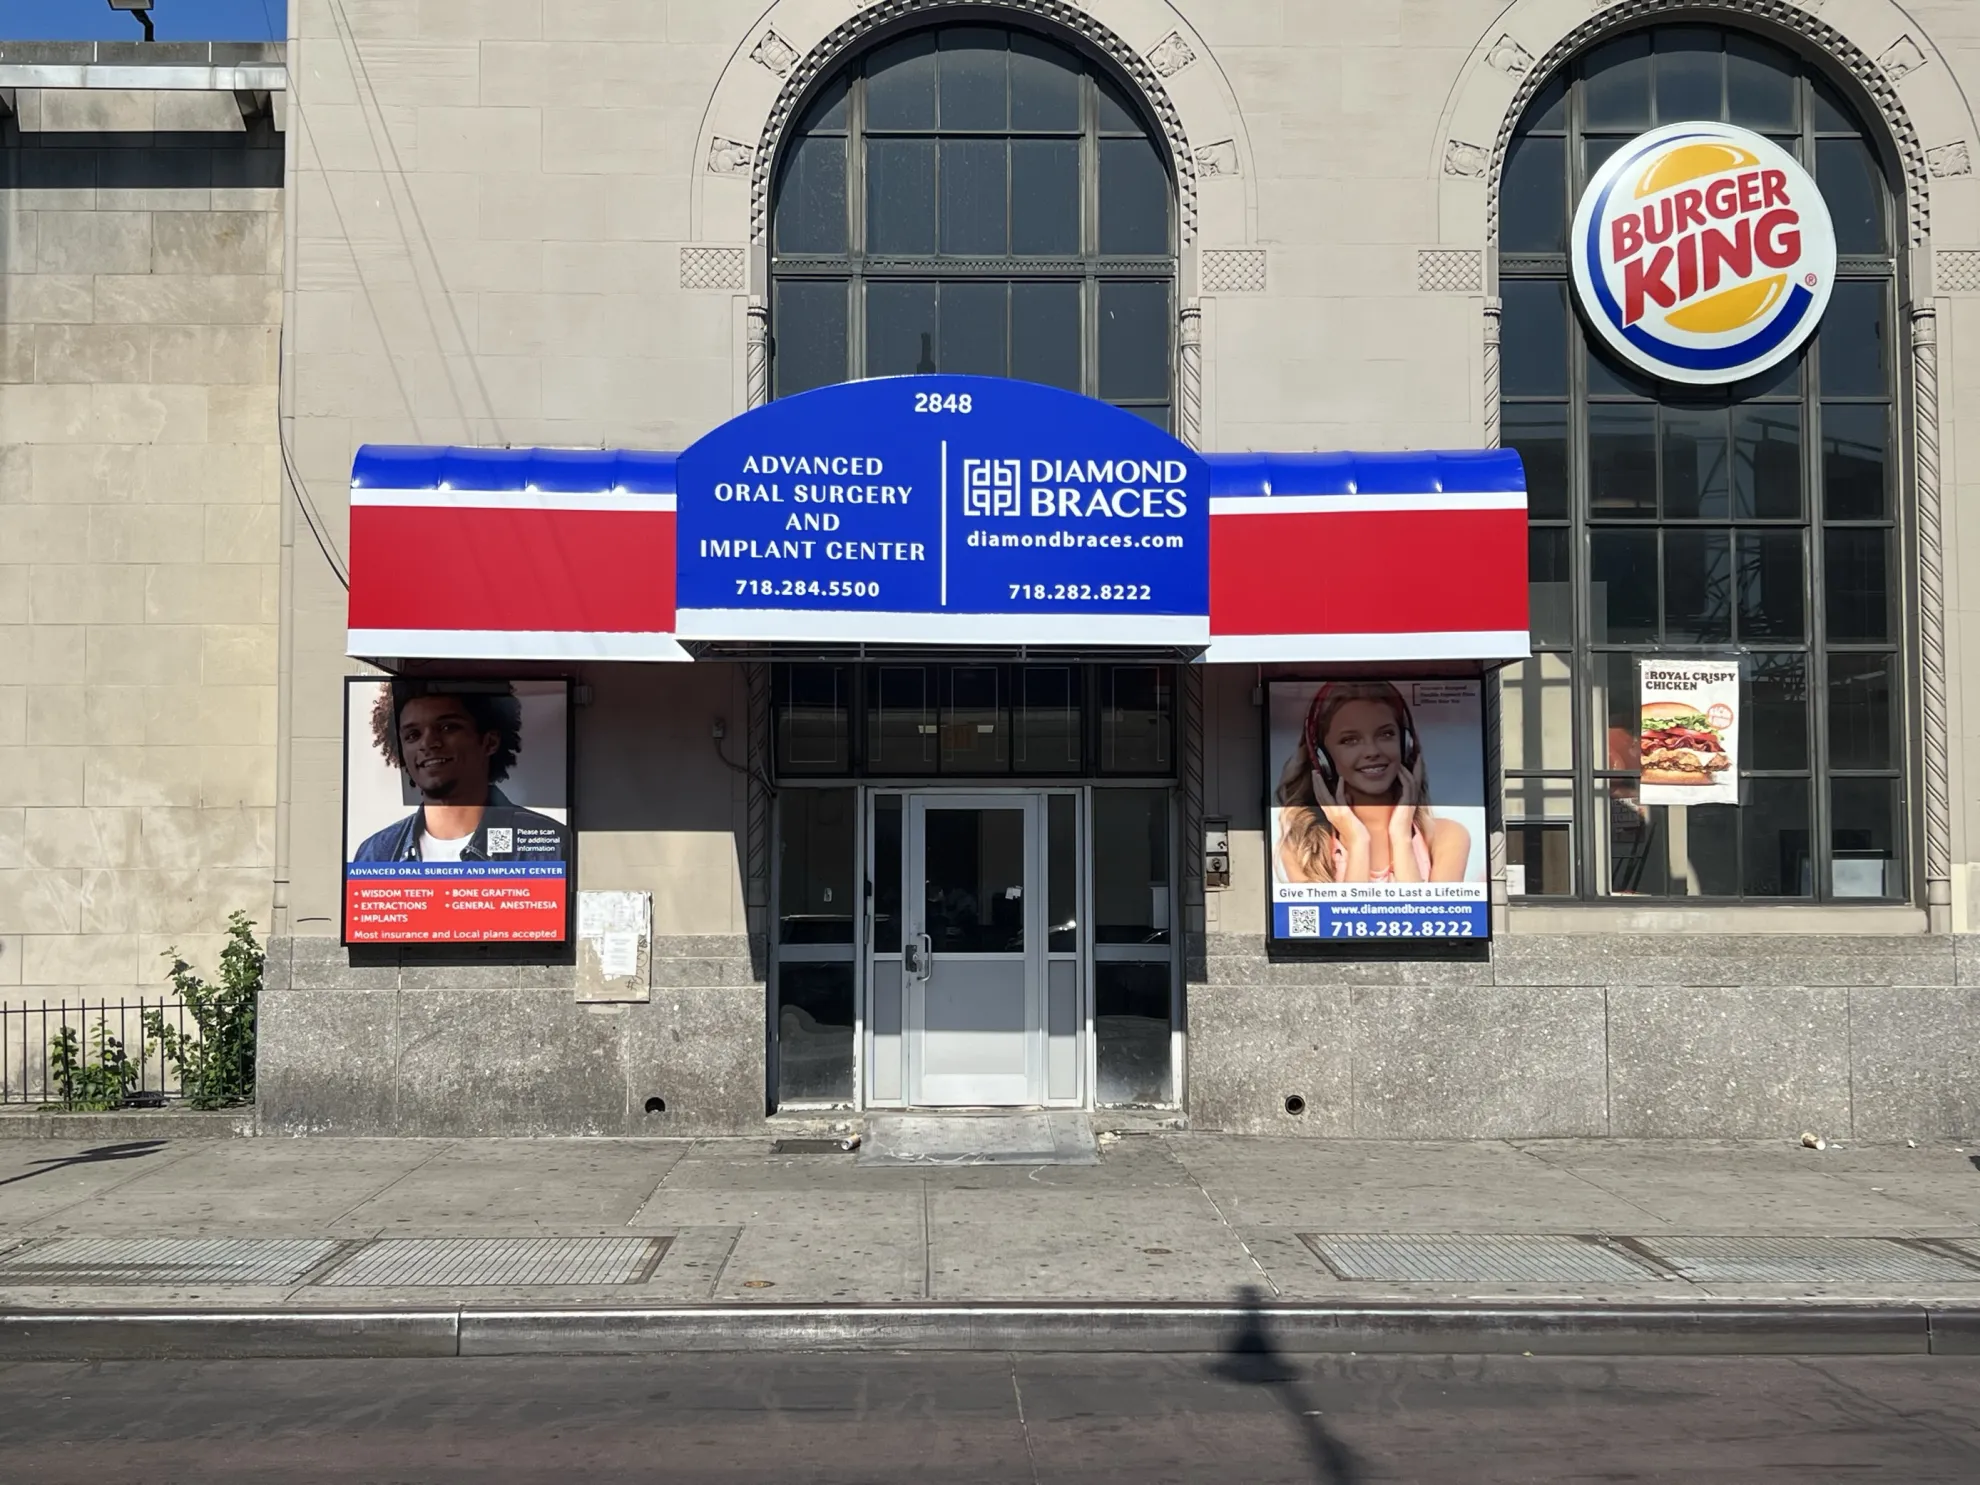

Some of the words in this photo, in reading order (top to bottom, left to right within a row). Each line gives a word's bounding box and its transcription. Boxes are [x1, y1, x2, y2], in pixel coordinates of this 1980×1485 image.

[1612, 169, 1791, 264] BURGER
[1624, 209, 1801, 327] KING
[914, 392, 973, 414] 2848
[742, 455, 883, 476] ADVANCED
[1031, 459, 1187, 484] DIAMOND
[714, 482, 785, 502] ORAL
[793, 484, 913, 505] SURGERY
[1031, 487, 1187, 518] BRACES
[785, 512, 840, 532] AND
[966, 530, 1184, 548] diamondbraces.com
[700, 539, 817, 559] IMPLANT
[825, 541, 925, 561] CENTER
[735, 579, 880, 597] 718.284.5500
[1009, 584, 1151, 600] 718.282.8222
[1646, 681, 1697, 690] CHICKEN
[1650, 671, 1690, 680] ROYAL
[1692, 672, 1735, 684] CRISPY
[453, 889, 478, 897] BONE
[1280, 889, 1303, 897] Give
[1307, 888, 1337, 897] Them
[1351, 888, 1381, 897] Smile
[1385, 889, 1395, 897] to
[1399, 888, 1421, 897] Last
[1435, 888, 1480, 896] Lifetime
[361, 902, 427, 910] EXTRACTIONS
[501, 901, 557, 909] ANESTHESIA
[1331, 904, 1472, 914] www.diamondbraces.com
[454, 930, 480, 938] Local
[483, 930, 509, 940] plans
[512, 930, 556, 939] accepted
[1331, 921, 1472, 936] 718.282.8222
